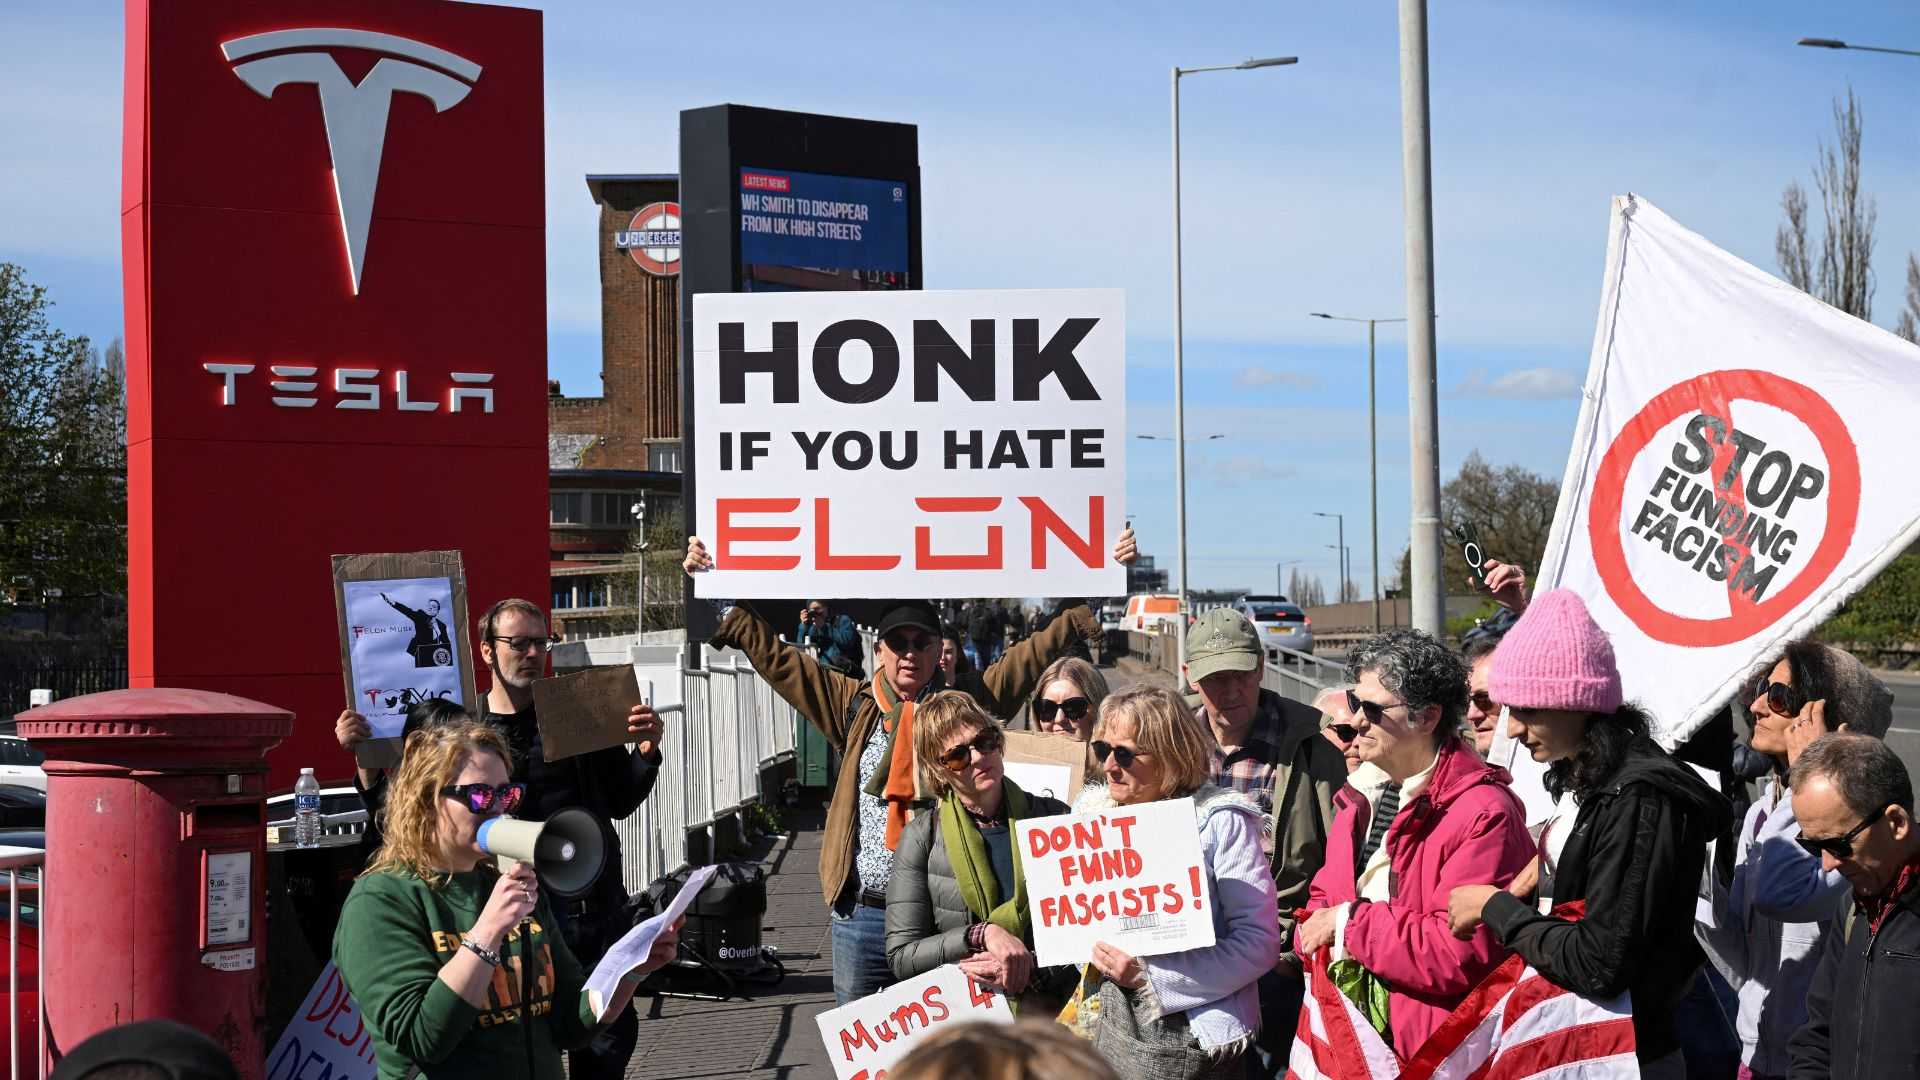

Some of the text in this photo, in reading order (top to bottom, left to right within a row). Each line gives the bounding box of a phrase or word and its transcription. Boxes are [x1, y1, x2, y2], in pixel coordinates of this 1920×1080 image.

[741, 193, 869, 221] WH SMITH TO DISAPPEAR
[743, 175, 787, 190] LATEST NEWS
[742, 215, 862, 241] FROM UK HIGH STREETS
[719, 318, 1102, 404] HONK
[203, 363, 495, 413] TESLA
[720, 428, 1105, 471] IF YOU HATE
[1671, 414, 1825, 519] STOP
[716, 495, 1105, 570] ELON
[1650, 466, 1798, 565] FUNDING
[1630, 499, 1779, 603] FACISM
[1028, 815, 1137, 858] DON'T
[1059, 848, 1143, 886] FUND
[839, 975, 995, 1062] Mums 4
